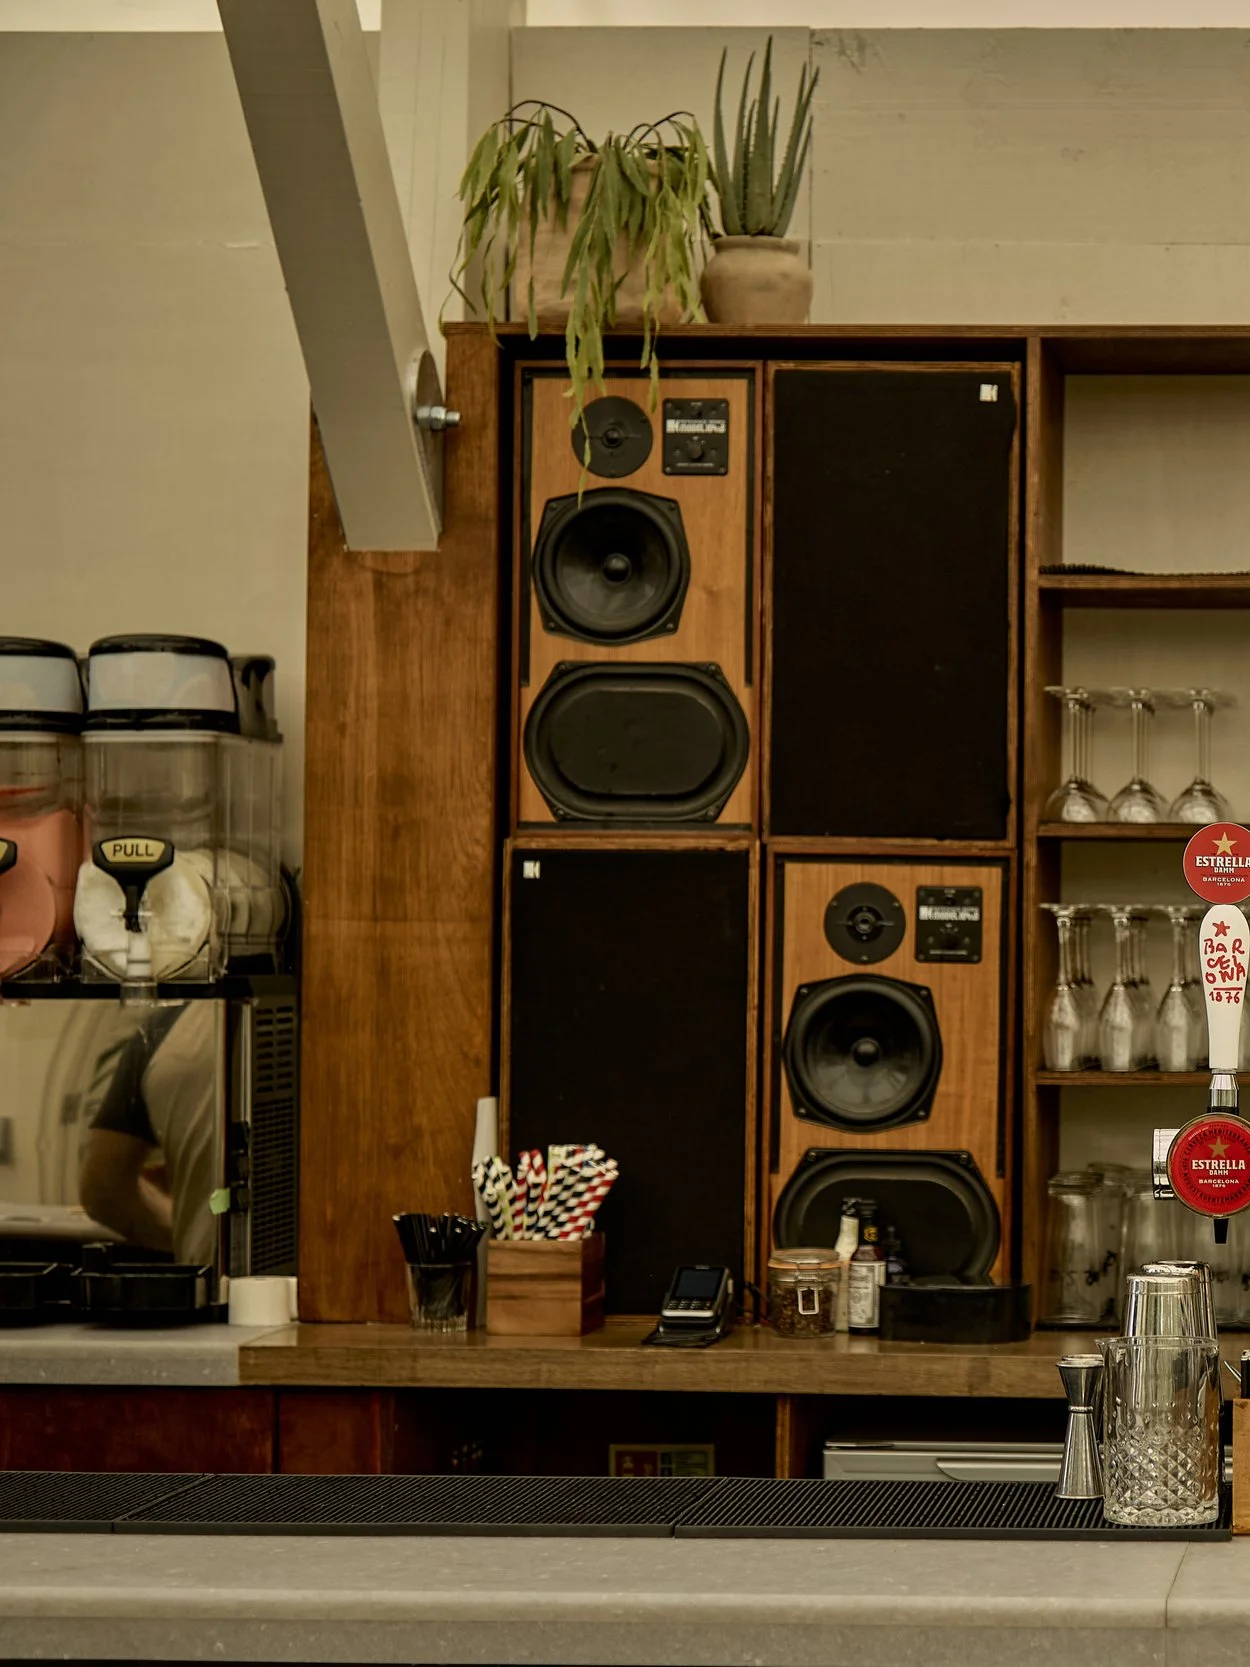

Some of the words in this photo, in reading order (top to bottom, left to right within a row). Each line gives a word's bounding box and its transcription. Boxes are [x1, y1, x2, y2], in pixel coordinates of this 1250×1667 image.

[112, 843, 154, 857] PULL
[1204, 939, 1245, 955] BAR
[1209, 991, 1240, 1004] 1876
[1192, 1160, 1246, 1170] ESTRELLA
